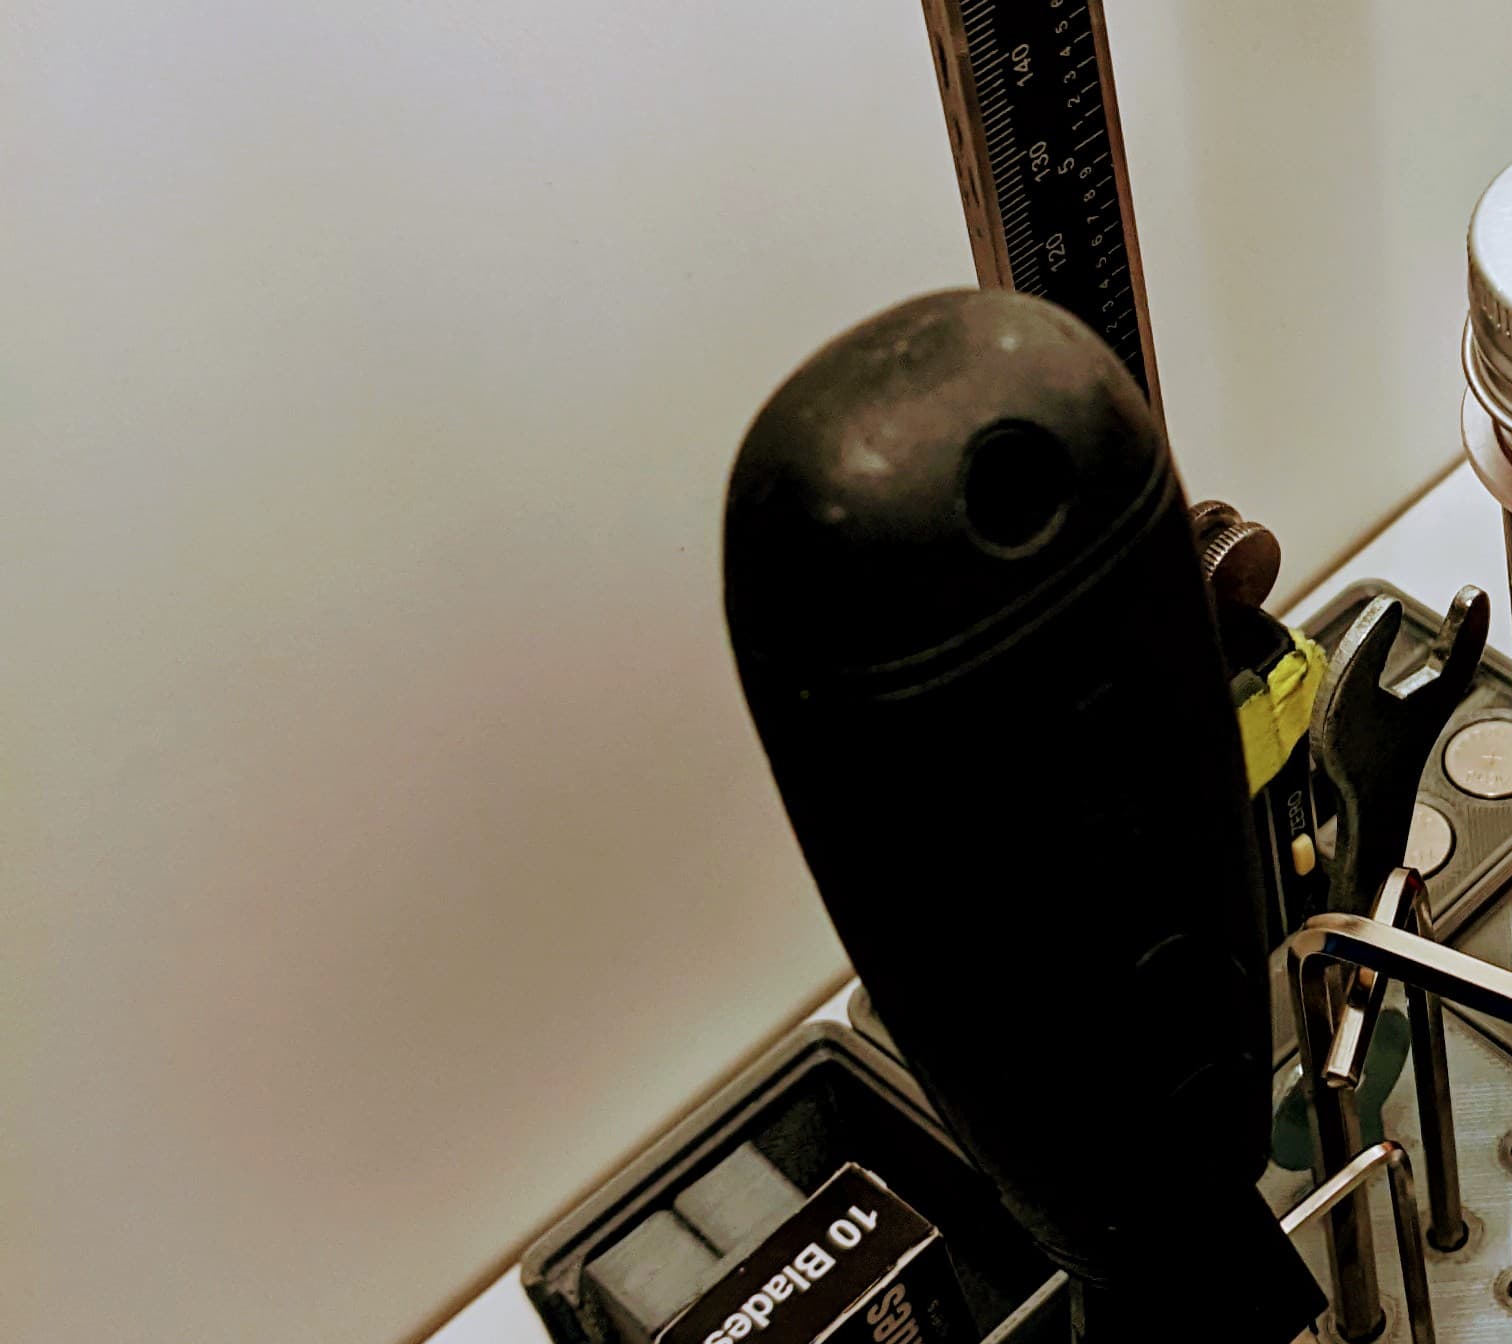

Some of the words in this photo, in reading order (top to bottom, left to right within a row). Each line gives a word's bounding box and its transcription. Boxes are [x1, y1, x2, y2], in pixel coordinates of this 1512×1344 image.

[1055, 20, 1068, 34] 5
[1011, 43, 1034, 87] 140
[1063, 70, 1076, 84] 3
[1067, 95, 1081, 108] 2
[1029, 141, 1051, 182] 130
[1057, 157, 1075, 175] 5
[1045, 232, 1067, 272] 120
[1287, 789, 1307, 837] ZERO
[827, 1204, 879, 1250] 10
